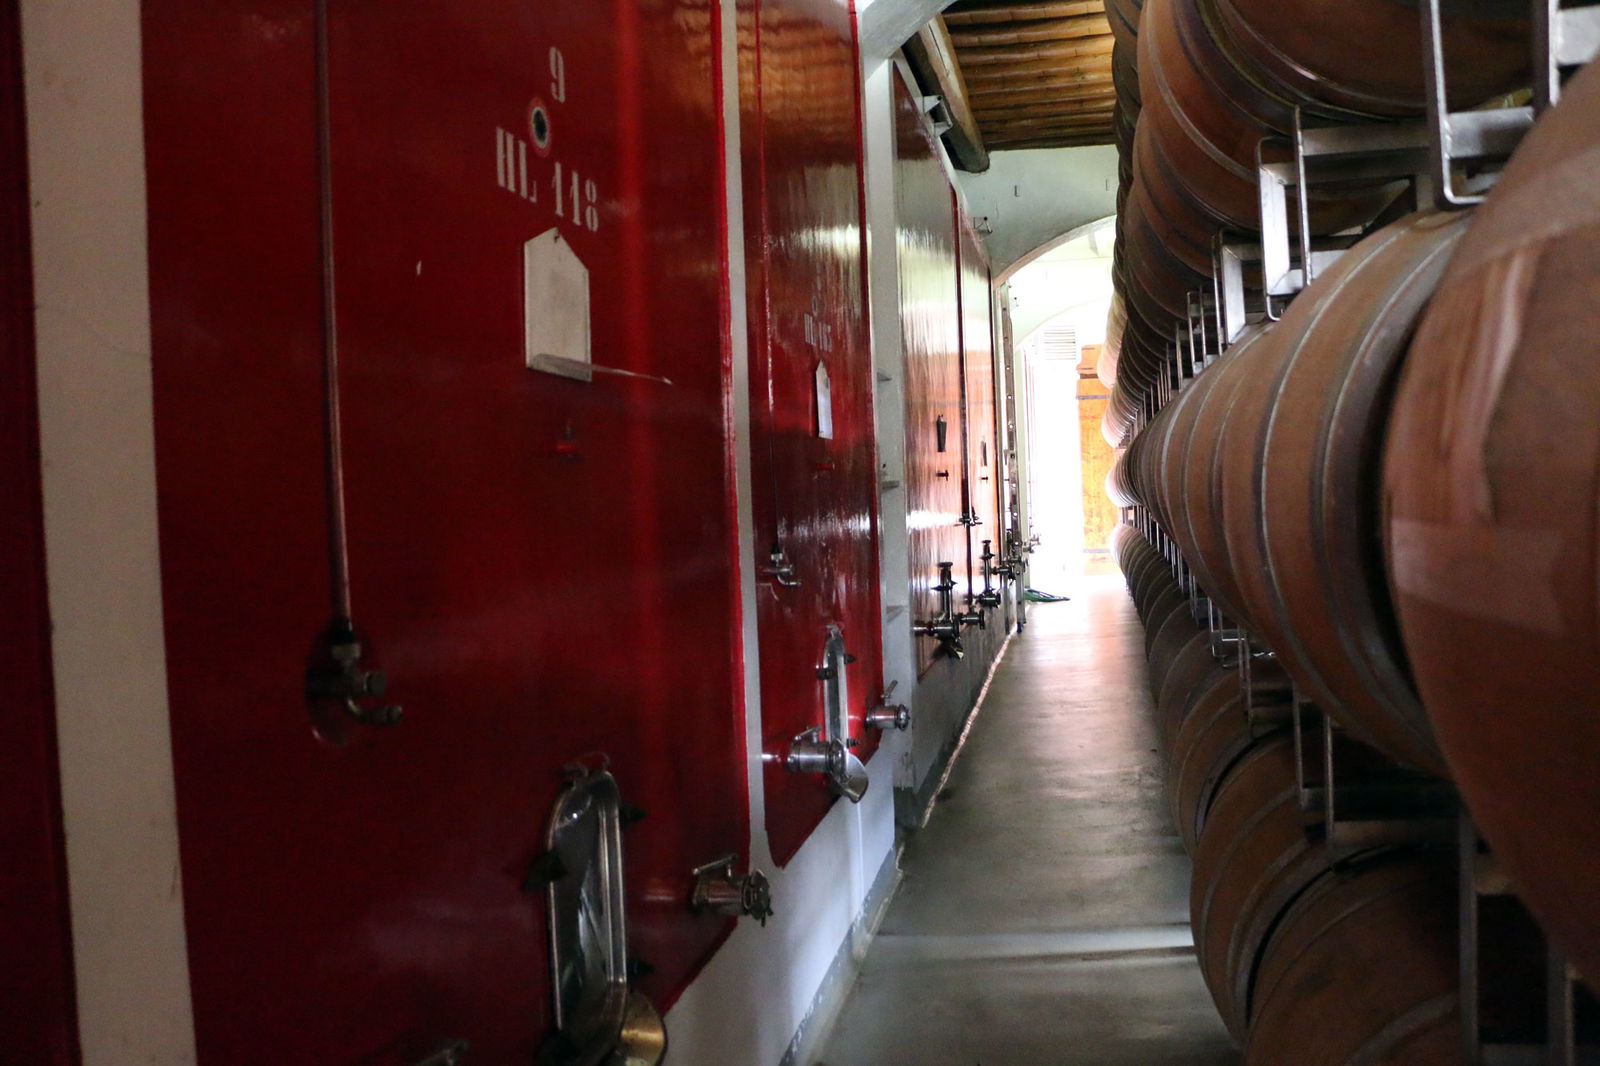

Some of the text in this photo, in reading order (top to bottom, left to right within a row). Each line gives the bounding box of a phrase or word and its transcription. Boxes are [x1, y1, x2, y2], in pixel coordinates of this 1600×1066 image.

[549, 46, 565, 103] 9
[496, 126, 598, 231] HL 118
